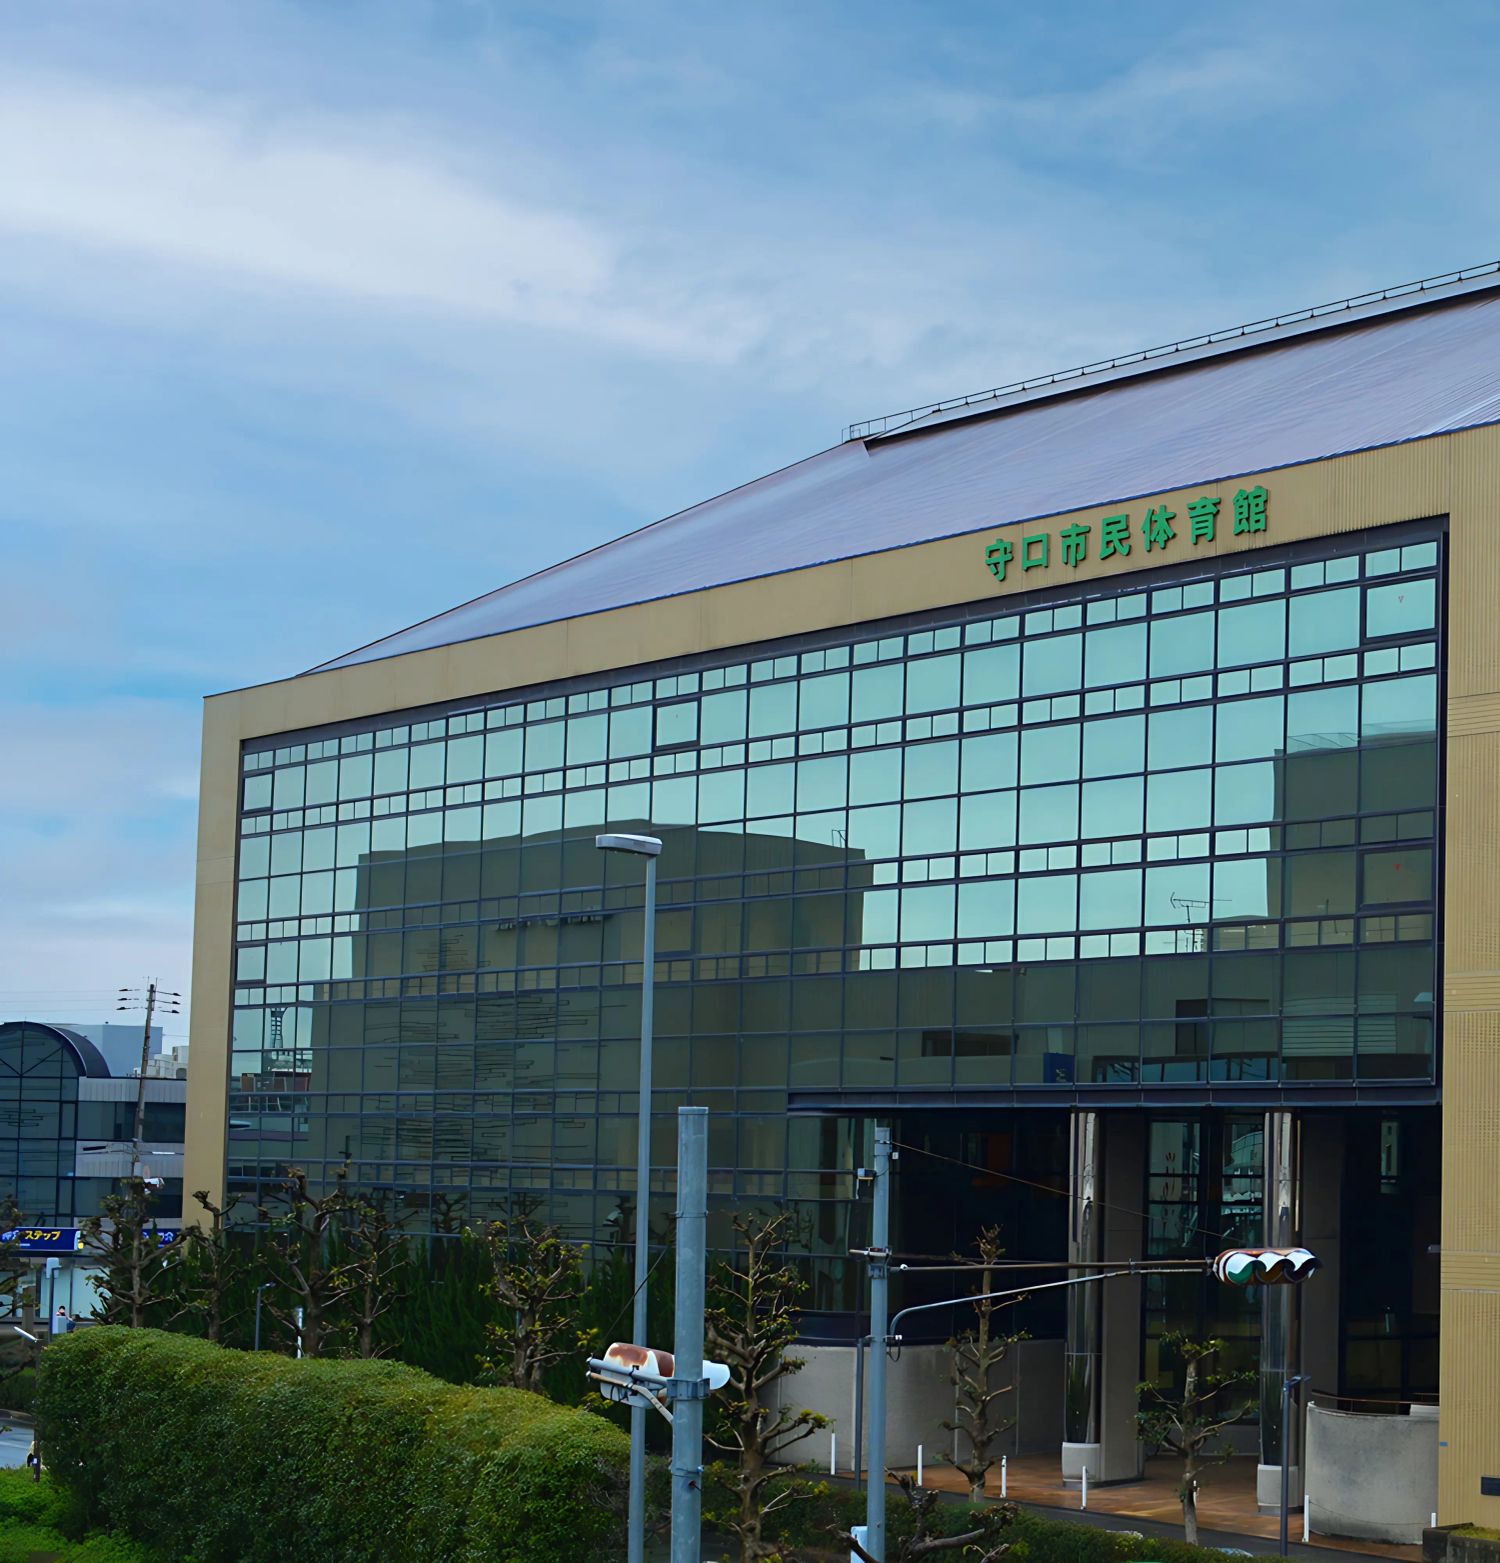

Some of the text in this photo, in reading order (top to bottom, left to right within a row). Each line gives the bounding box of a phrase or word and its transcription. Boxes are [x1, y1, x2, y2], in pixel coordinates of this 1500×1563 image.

[984, 485, 1269, 582] 守口市民体育館
